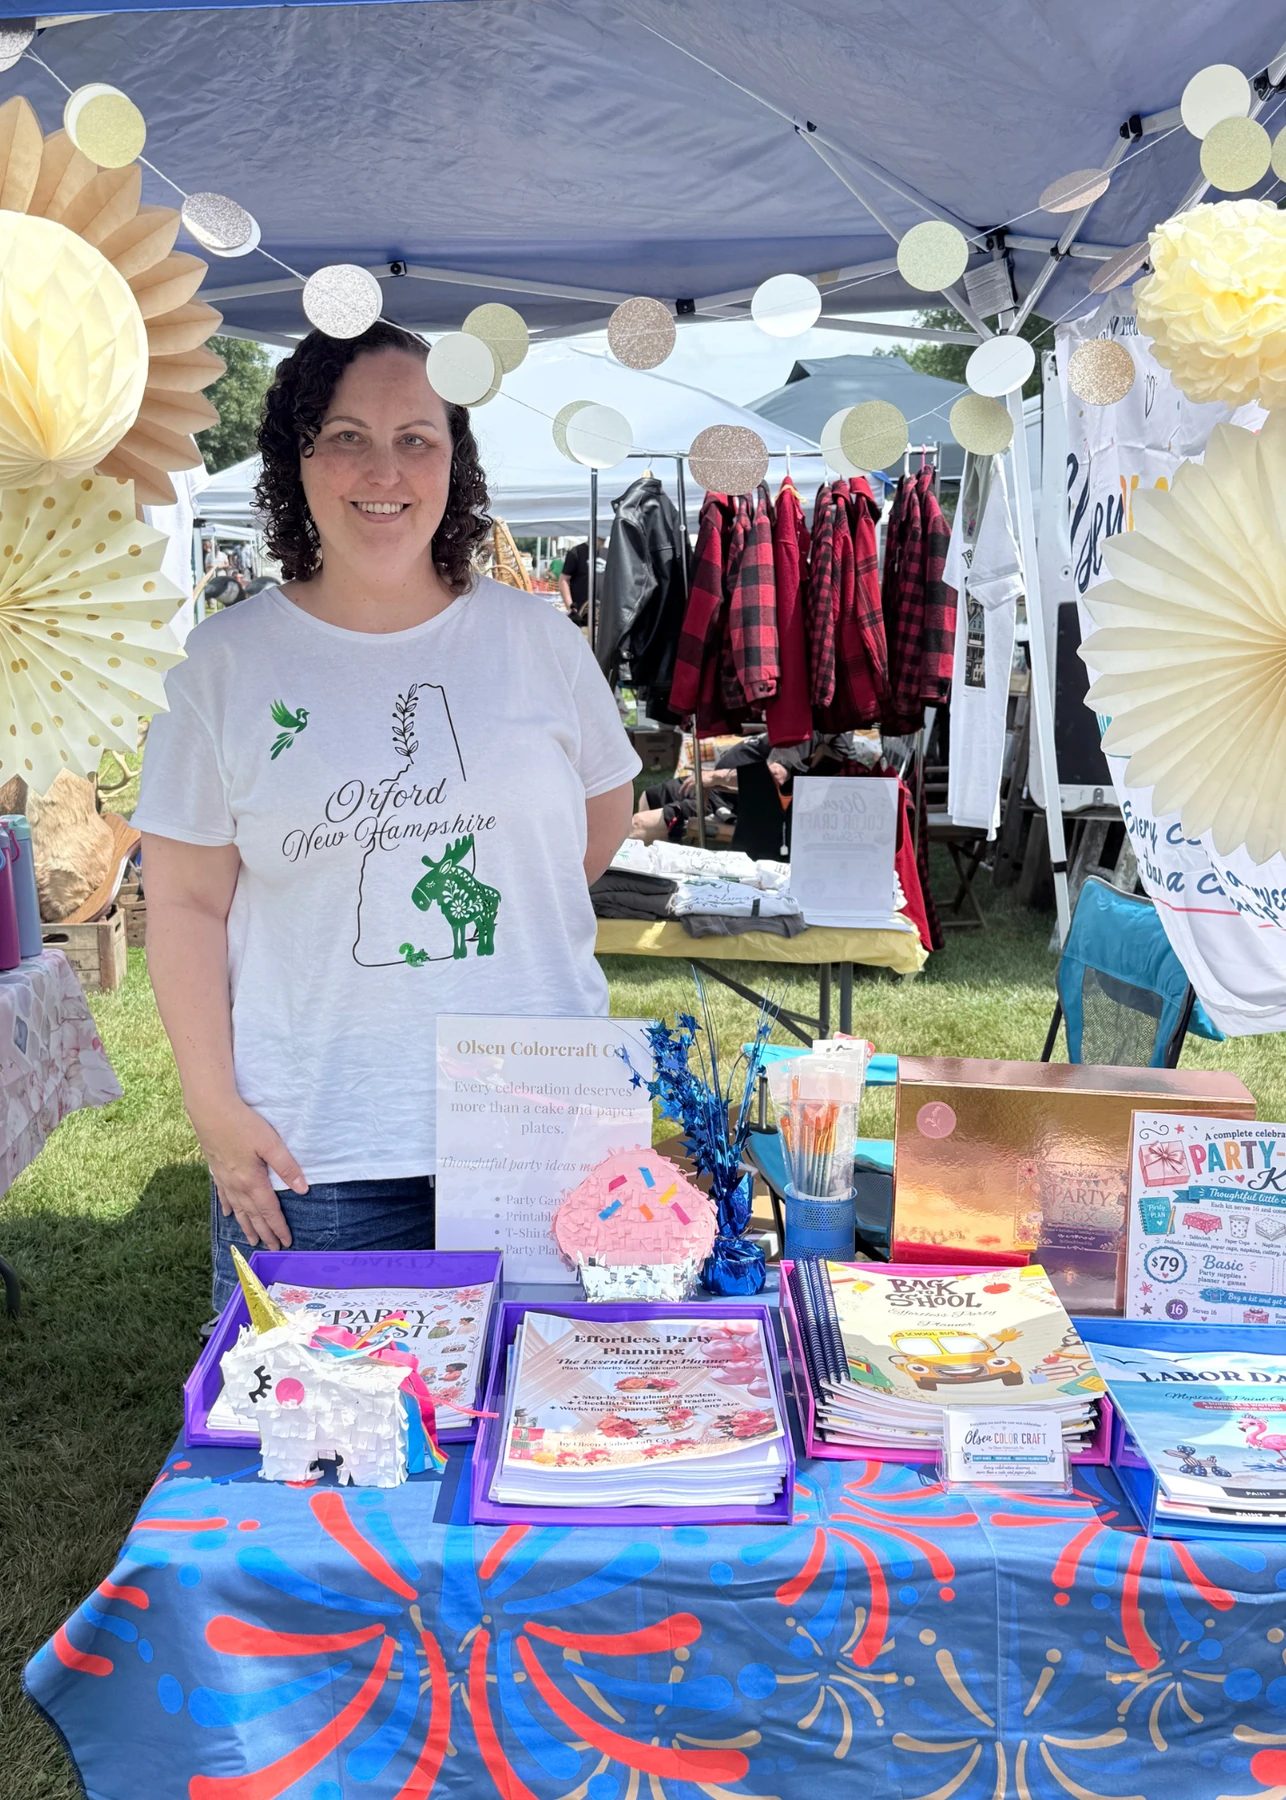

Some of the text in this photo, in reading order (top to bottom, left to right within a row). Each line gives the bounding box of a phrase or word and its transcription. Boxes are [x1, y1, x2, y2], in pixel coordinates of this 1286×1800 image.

[325, 778, 447, 823] Orford
[282, 813, 497, 862] New Hampshire
[456, 1039, 505, 1056] Olsen
[510, 1041, 598, 1058] Colorcraft
[454, 1081, 632, 1097] Every celebration deserves
[451, 1102, 635, 1119] more than a cake and paper
[521, 1121, 564, 1136] plates.
[1205, 1128, 1286, 1141] A complete celebra
[440, 1156, 507, 1171] Thoughtful
[510, 1159, 542, 1172] party
[545, 1159, 576, 1171] ideas
[506, 1194, 536, 1207] Party
[1050, 1184, 1112, 1207] PARTY
[1210, 1189, 1258, 1202] Thoughtful
[1259, 1193, 1280, 1204] little
[505, 1244, 535, 1256] Party
[1151, 1256, 1179, 1272] $79
[1203, 1254, 1244, 1271] Basic
[1199, 1269, 1215, 1277] Party
[887, 1279, 959, 1296] BACK
[885, 1292, 982, 1308] SCHOOL
[1170, 1303, 1183, 1315] 16
[574, 1335, 713, 1345] Effortless Party
[603, 1347, 685, 1356] Planning
[1138, 1371, 1286, 1384] LABOR DA
[964, 1429, 1046, 1445] Olsen COLOR CRAFT
